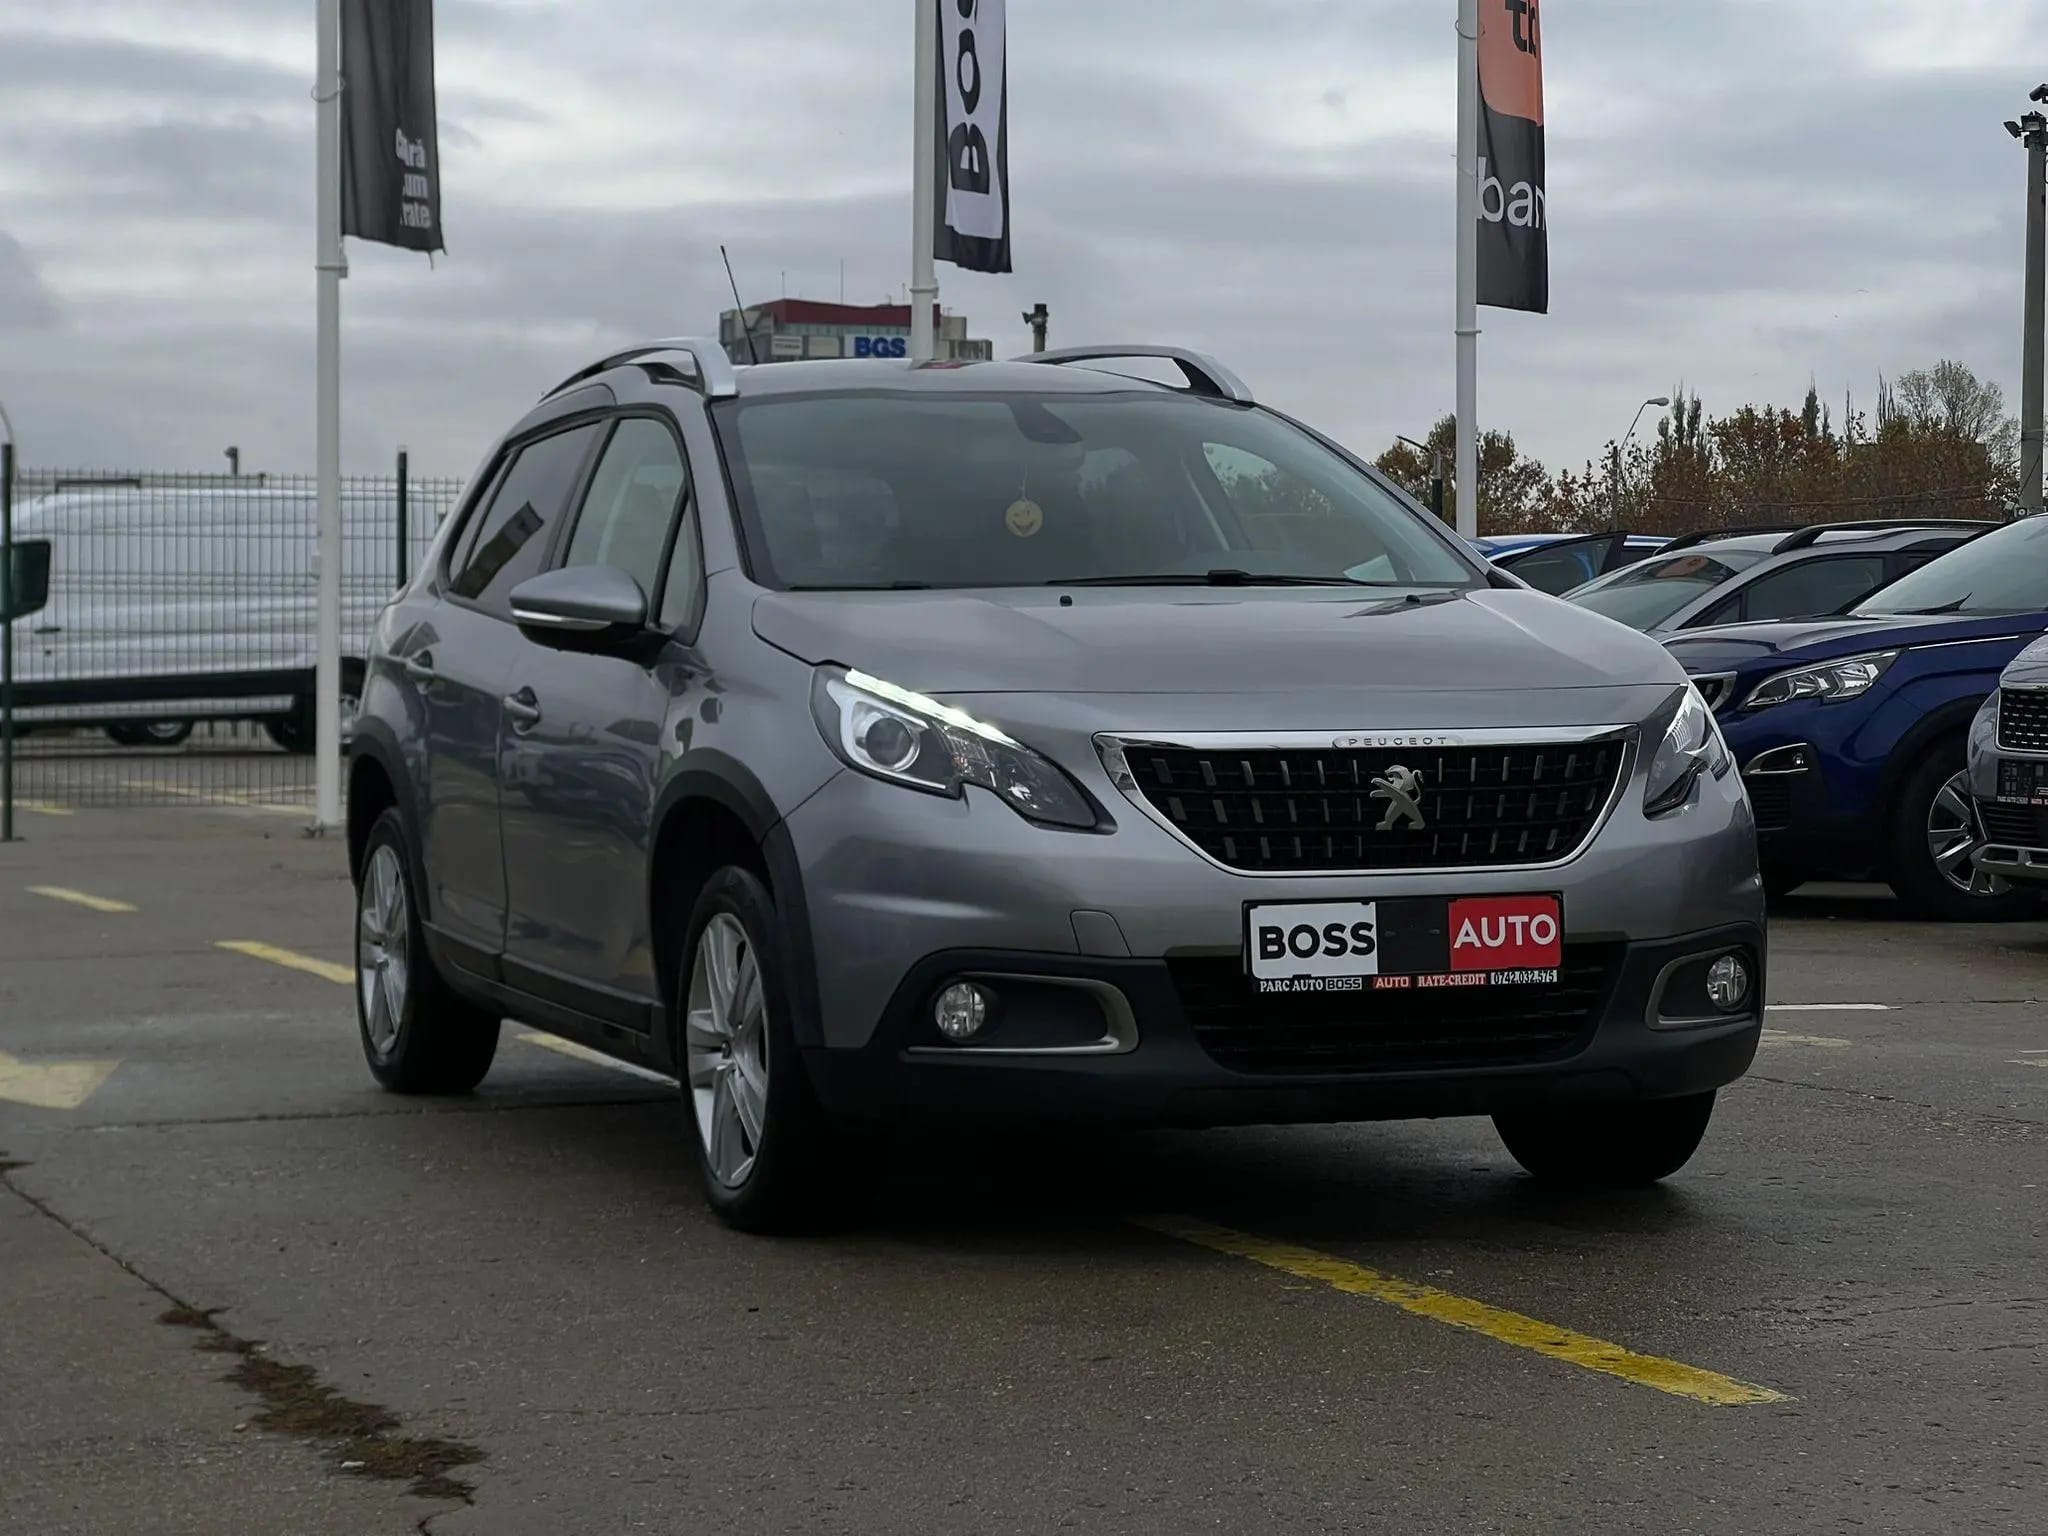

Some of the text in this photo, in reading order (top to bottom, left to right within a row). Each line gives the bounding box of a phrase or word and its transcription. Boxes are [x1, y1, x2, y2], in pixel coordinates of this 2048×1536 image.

[1349, 737, 1446, 746] PEUGEOT
[1259, 914, 1556, 960] BOSS AUTO
[1260, 979, 1290, 992] PARC
[1292, 979, 1323, 991] AUTO
[1326, 977, 1362, 990] BOSS
[1375, 976, 1409, 988] AUTO
